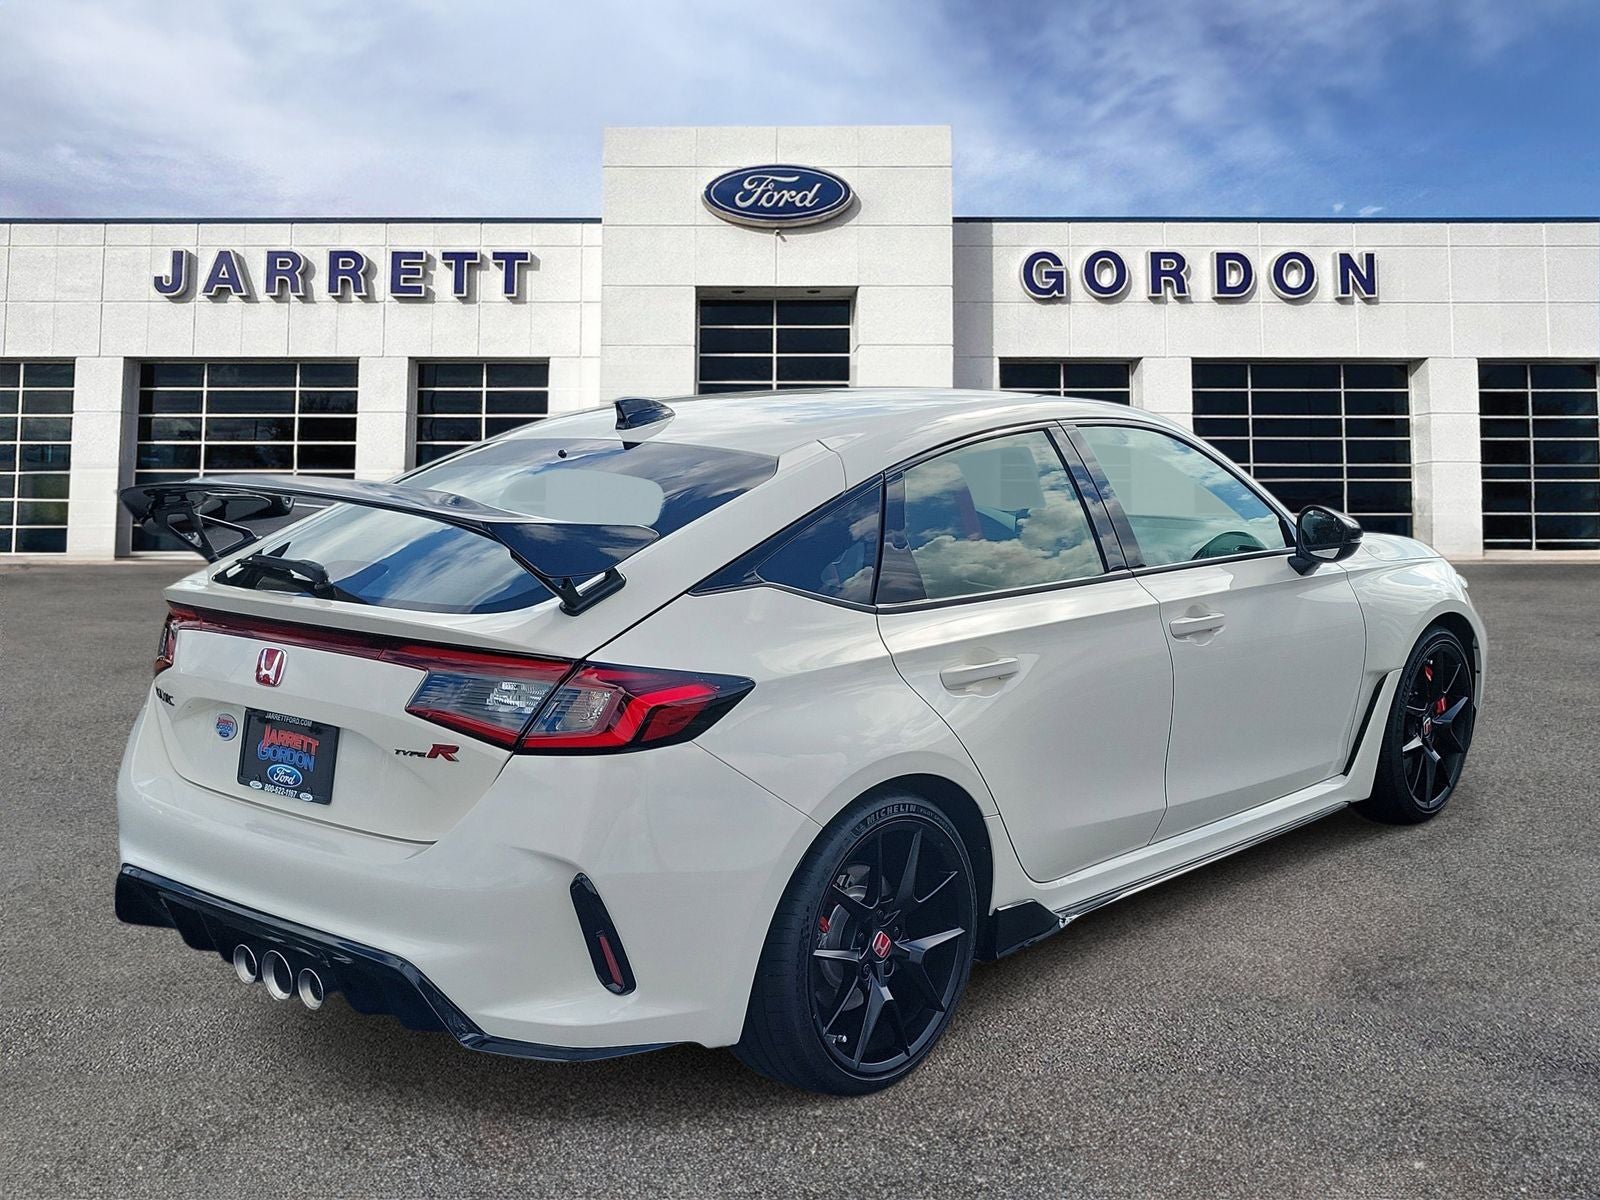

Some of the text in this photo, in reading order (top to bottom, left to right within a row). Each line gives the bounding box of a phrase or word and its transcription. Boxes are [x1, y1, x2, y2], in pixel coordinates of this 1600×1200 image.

[734, 174, 822, 209] Ford
[153, 248, 534, 299] JARRETT
[1020, 249, 1380, 301] GORDON
[265, 712, 312, 727] JARRETTFORD.COM
[257, 738, 315, 772] GORDON
[262, 723, 320, 756] JARRETT
[394, 743, 460, 762] TYPE R
[273, 766, 296, 785] Ford
[866, 803, 917, 825] MICHELIN
